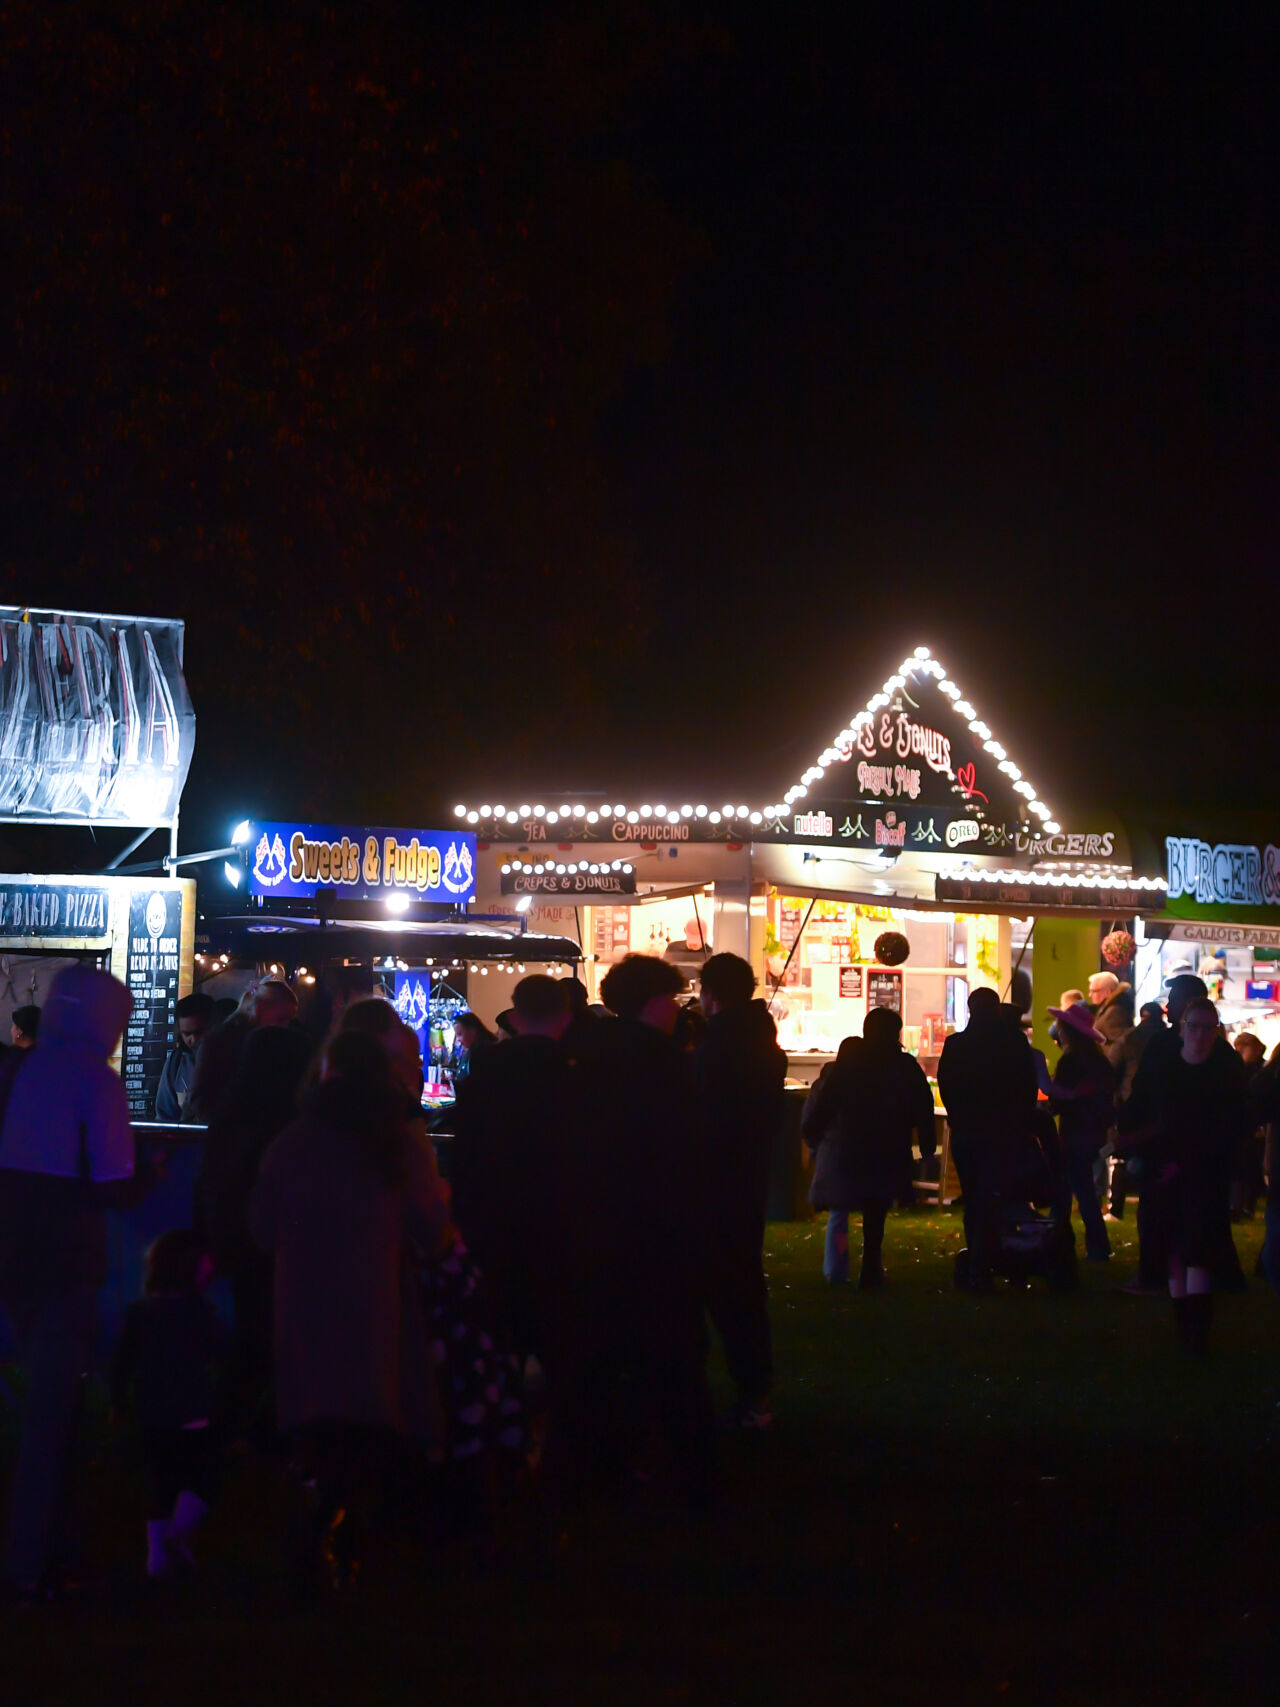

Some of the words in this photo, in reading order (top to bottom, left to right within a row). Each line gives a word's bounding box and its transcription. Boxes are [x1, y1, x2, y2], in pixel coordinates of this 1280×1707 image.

[880, 713, 894, 748] &
[896, 714, 952, 772] DONUTS
[857, 761, 894, 796] FRESHLY
[895, 765, 920, 799] MADE
[523, 821, 546, 841] TEA
[612, 822, 689, 841] CAPPUCCINO
[795, 811, 832, 836] nutella
[875, 819, 906, 846] Biscoff
[948, 823, 979, 843] OREO
[1016, 832, 1115, 856] URGERS
[290, 832, 359, 884] Sweets
[364, 836, 380, 885] &
[384, 837, 441, 891] Fudge
[1165, 836, 1263, 904] BURGER
[514, 875, 558, 892] CREPES
[561, 876, 570, 889] &
[575, 875, 623, 893] DONUTS
[12, 892, 60, 926] BAKED
[65, 894, 105, 928] PIZZA
[130, 955, 149, 970] READY
[133, 937, 148, 953] MADE
[150, 938, 157, 953] TO
[159, 938, 177, 953] ORDER
